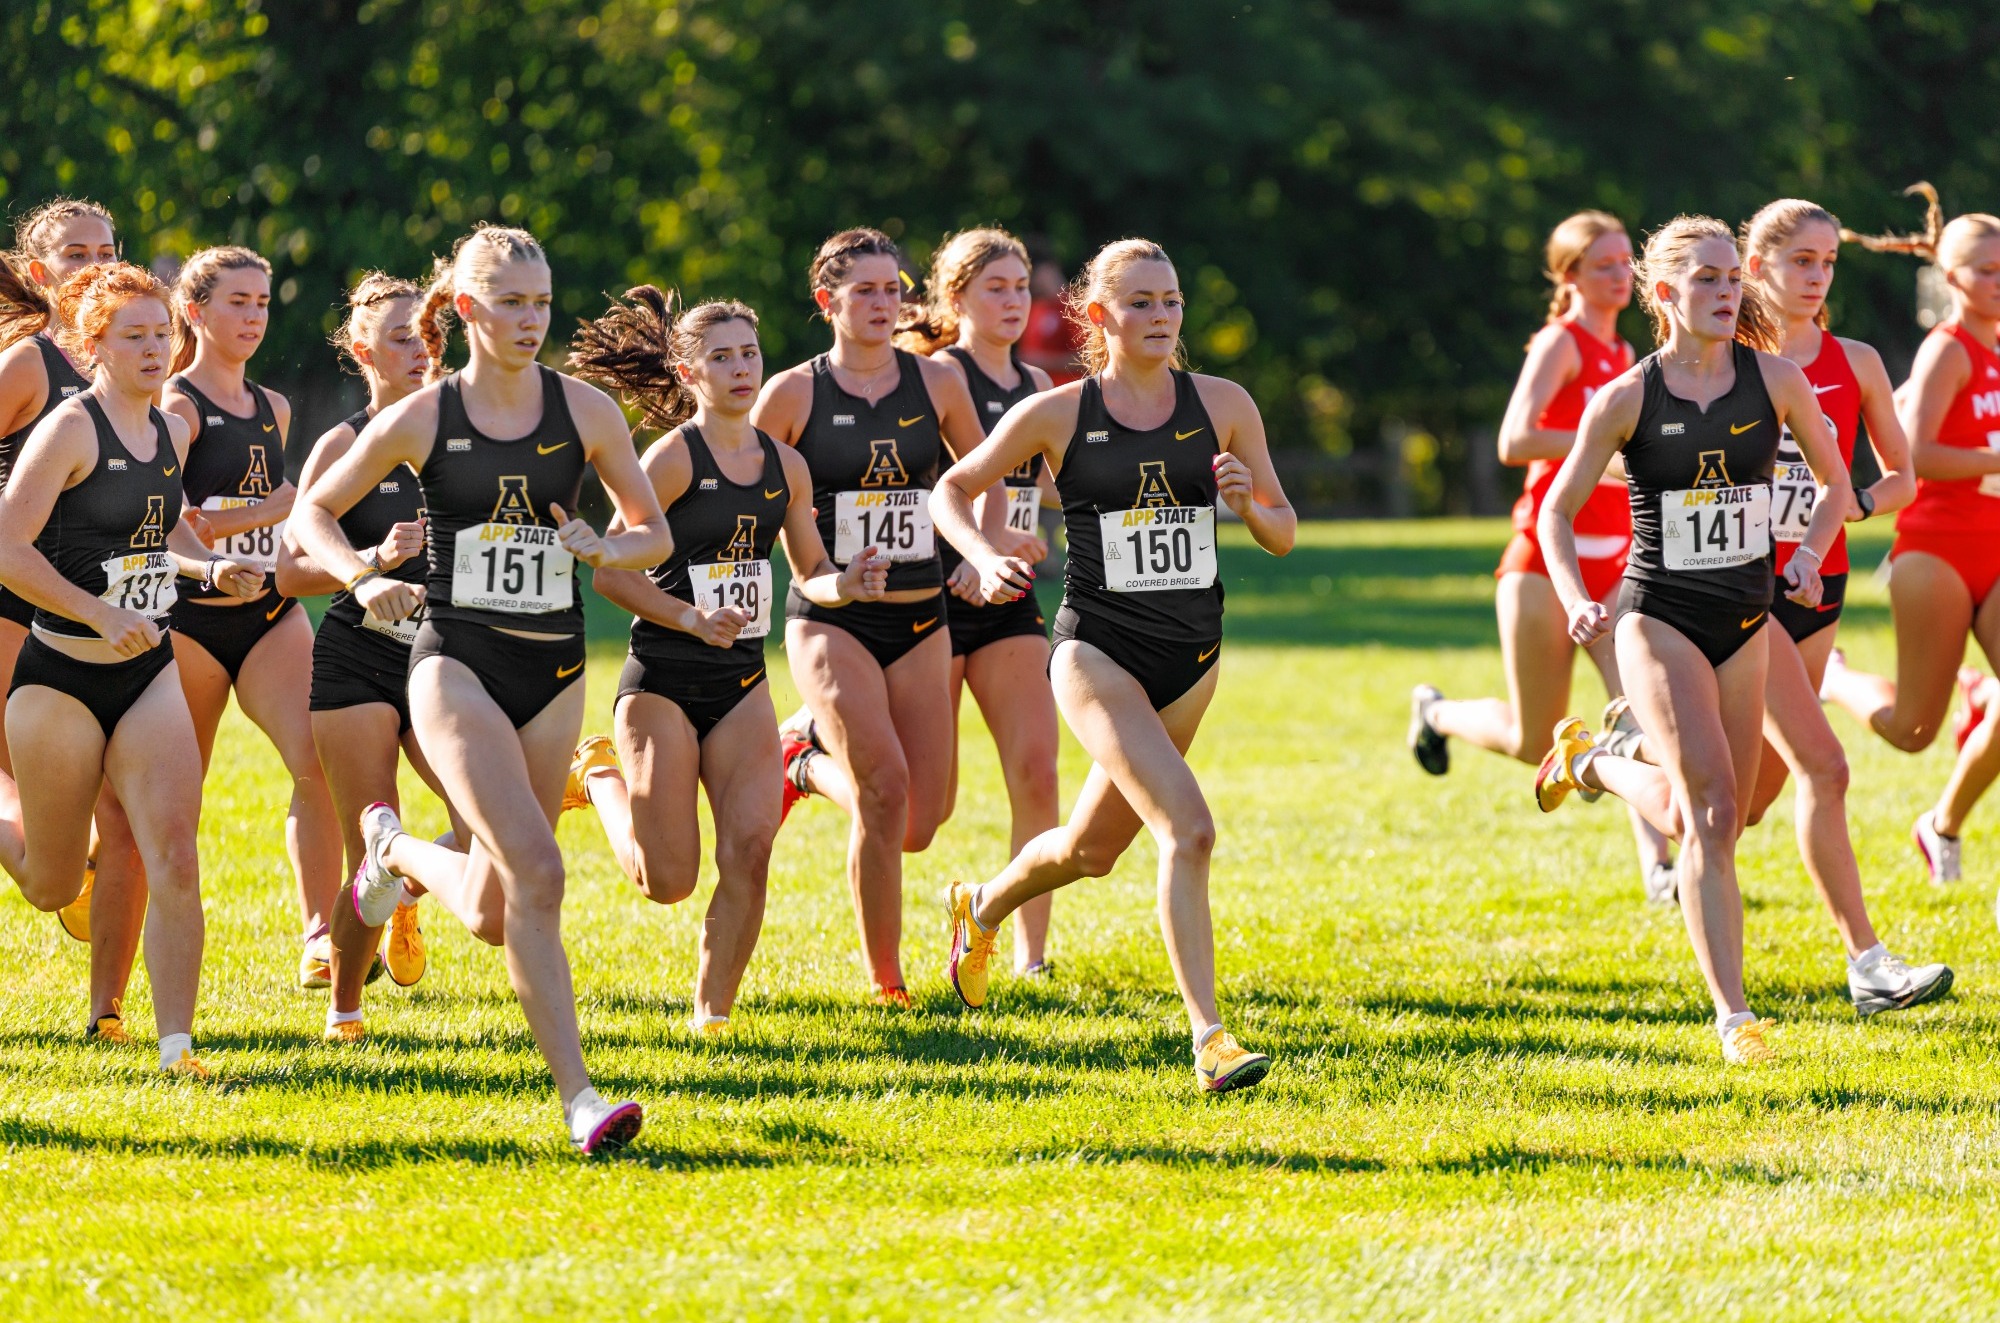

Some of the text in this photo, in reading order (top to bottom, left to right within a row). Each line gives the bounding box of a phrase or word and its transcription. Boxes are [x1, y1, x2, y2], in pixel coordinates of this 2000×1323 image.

[1086, 431, 1109, 442] SBC
[238, 444, 272, 495] A
[861, 439, 909, 488] A
[856, 491, 920, 506] APPSTATE
[1683, 486, 1752, 507] APPSTATE
[1778, 485, 1816, 526] 73
[130, 495, 164, 548] A
[479, 525, 556, 546] APPSTATE
[858, 510, 914, 550] 145
[1122, 508, 1196, 528] APPSTATE
[1686, 508, 1746, 553] 141
[226, 526, 274, 556] 138
[718, 515, 757, 561] A
[1127, 528, 1192, 575] 150
[481, 546, 546, 596] 151
[708, 562, 761, 580] APPSTATE
[1682, 552, 1754, 567] COVERED BRIDGE
[120, 572, 168, 610] 137
[713, 581, 758, 622] 139
[1126, 577, 1201, 588] COVERED BRIDGE
[472, 597, 554, 610] COVERED BRIDGE
